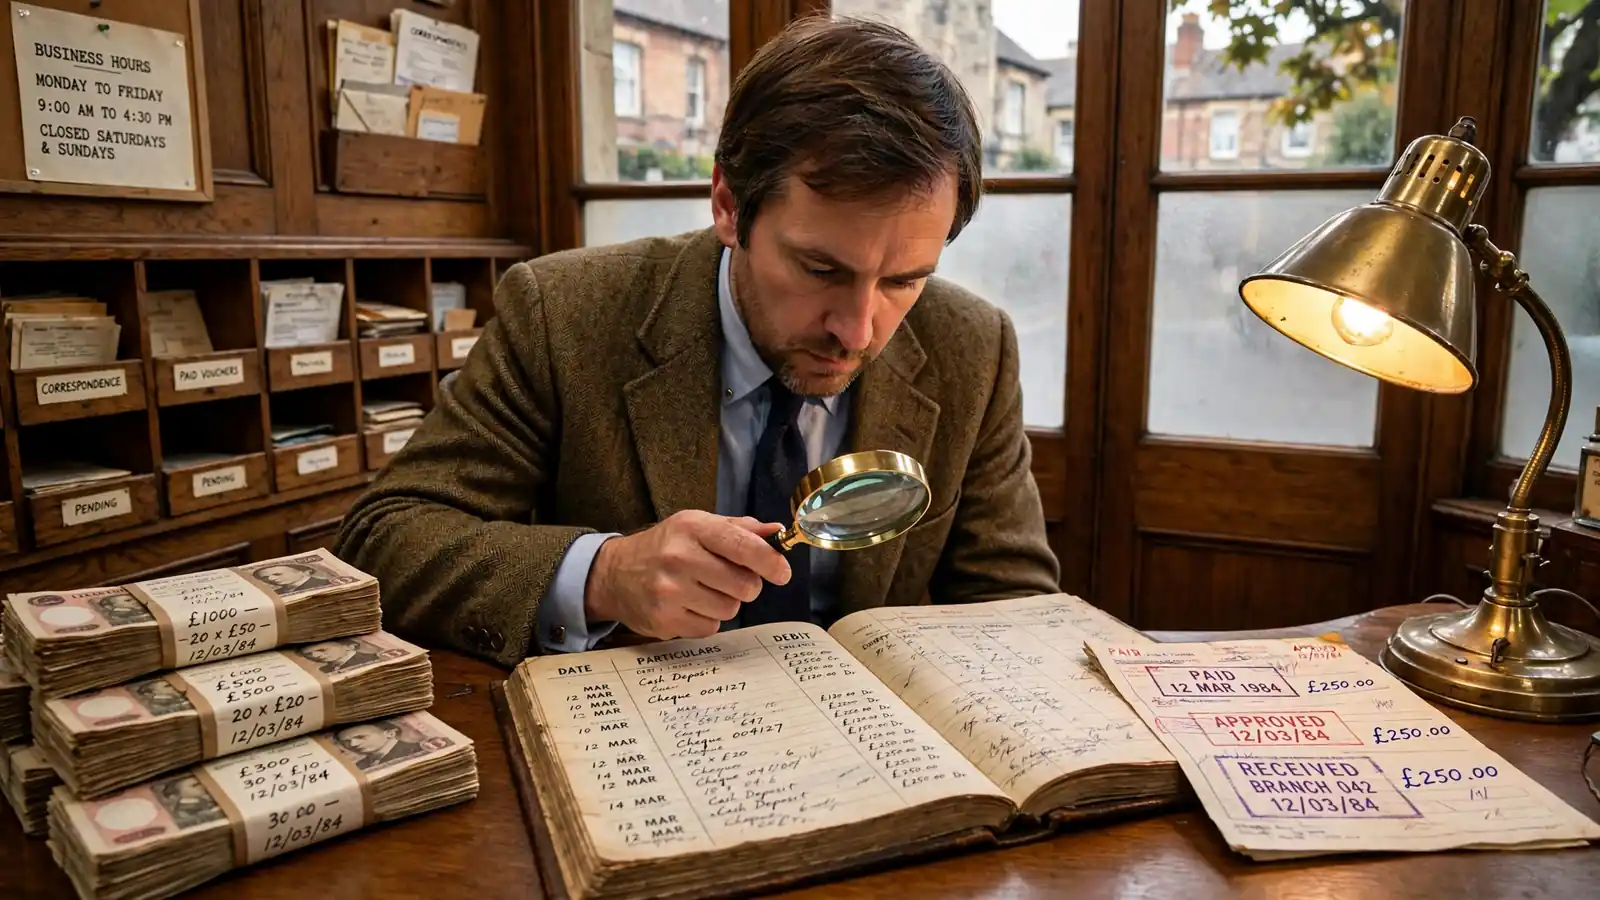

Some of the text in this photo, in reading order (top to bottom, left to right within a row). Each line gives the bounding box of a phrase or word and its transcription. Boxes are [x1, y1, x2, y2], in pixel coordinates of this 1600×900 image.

[35, 43, 151, 73] BUSINESS HOURS
[36, 73, 163, 102] MONDAY TO FRIDAY
[38, 99, 172, 126] 9:00 AM TO 4:30 PM
[40, 124, 165, 148] CLOSED SATURDAYS
[41, 142, 115, 160] & SUNDAYS
[180, 366, 239, 381] PAID VOUCHERS
[41, 376, 121, 395] CORRESPONDENCE
[202, 473, 235, 487] PENDING
[75, 498, 117, 516] PENDING
[188, 607, 237, 628] £1000
[228, 622, 256, 638] £50
[773, 632, 812, 642] DEBIT
[188, 638, 256, 662] 12/03/84
[637, 645, 722, 665] PARTICULARS
[1108, 647, 1142, 657] PAID
[558, 664, 592, 676] DATE
[639, 675, 665, 686] Cash
[672, 667, 721, 682] Deposit
[1189, 670, 1236, 681] PAID
[216, 675, 267, 691] £500
[583, 684, 610, 692] MAR
[1170, 683, 1282, 693] 12 MAR 1984
[1308, 679, 1374, 693] £250.00
[226, 684, 275, 703] £500
[587, 691, 613, 700] MAR
[648, 682, 747, 705] Cheque 004127
[232, 707, 252, 723] 20
[274, 694, 304, 713] £20
[590, 700, 618, 709] MAR
[594, 707, 622, 717] MAR
[231, 715, 304, 744] 12/03/84
[600, 722, 629, 732] MAR
[1214, 715, 1326, 728] APPROVED
[676, 723, 783, 750] Cheque 004127
[1229, 729, 1330, 743] 12/03/84
[1373, 725, 1450, 744] £250.00
[585, 738, 638, 751] 12 MAR
[239, 757, 290, 778] £300
[592, 754, 647, 769] 12 MAR
[1237, 762, 1359, 777] RECEIVED
[243, 777, 266, 789] 30
[291, 761, 320, 776] £10
[597, 766, 651, 780] 14 MAR
[1401, 765, 1498, 789] £250.00
[250, 769, 330, 801] 12/03/84
[602, 775, 657, 790] 12 MAR
[1250, 780, 1377, 794] BRANCH 042
[708, 782, 797, 806] Cash Deposit
[756, 792, 808, 810] Deposit
[609, 795, 667, 811] 14 MAR
[1271, 797, 1380, 814] 12/03/84
[618, 814, 678, 832] 12 MAR
[651, 825, 685, 838] MAR
[264, 814, 343, 851] 12/03/84
